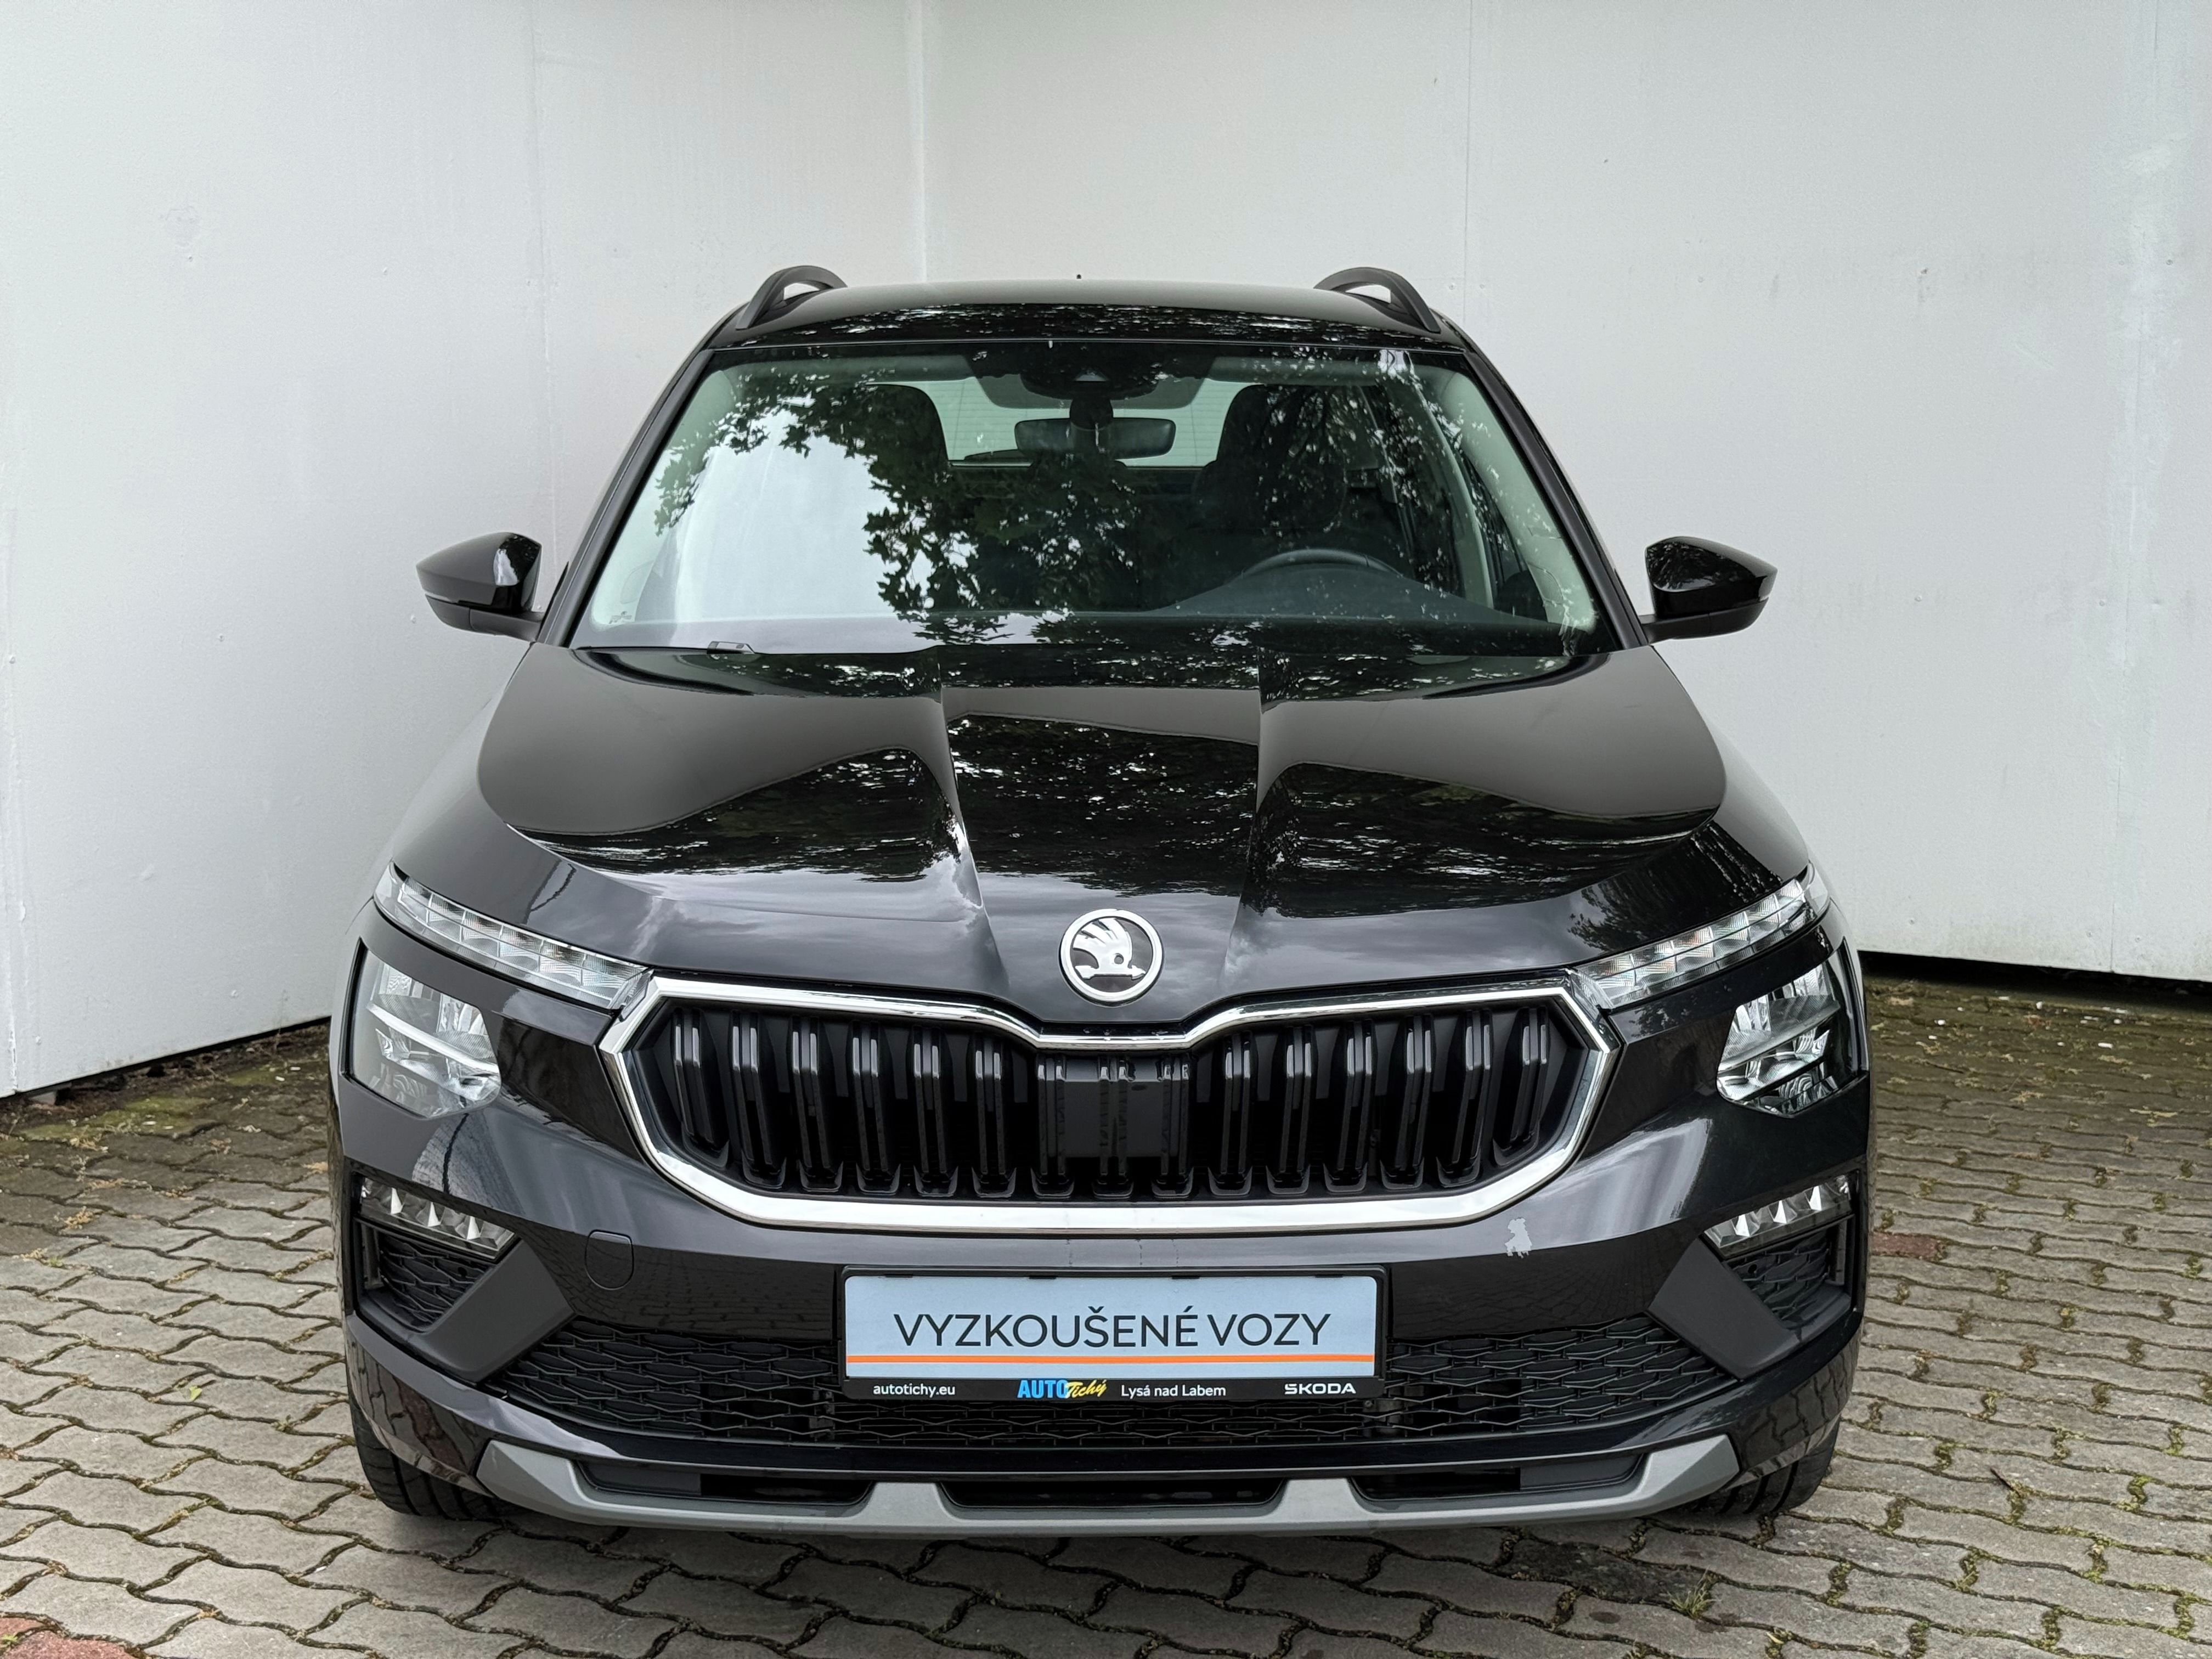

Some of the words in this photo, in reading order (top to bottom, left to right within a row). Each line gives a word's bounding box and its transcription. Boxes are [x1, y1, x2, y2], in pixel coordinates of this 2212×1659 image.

[894, 1306, 1198, 1348] VYZKOUŠENÉ
[1207, 1313, 1331, 1346] VOZY
[873, 1383, 956, 1398] autotichy.eu
[1121, 1384, 1151, 1400] Lysá
[1154, 1384, 1178, 1397] nad
[1182, 1384, 1226, 1397] Labem
